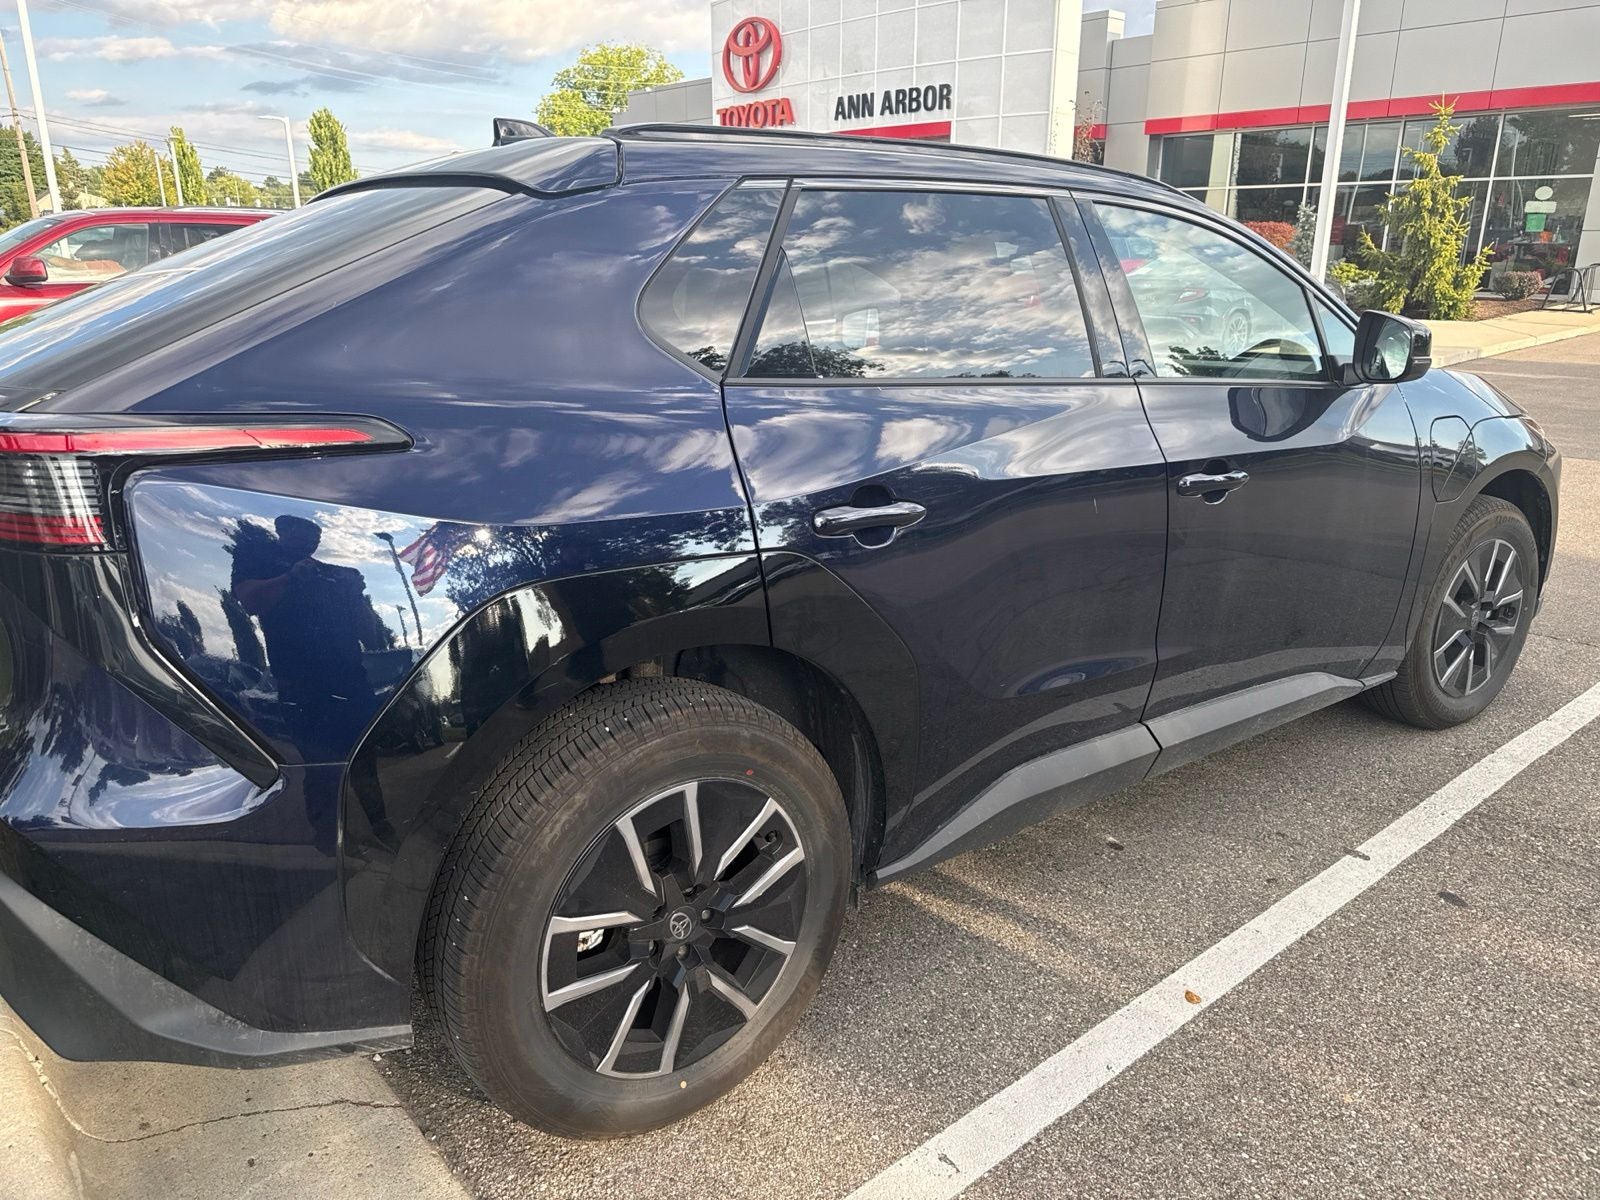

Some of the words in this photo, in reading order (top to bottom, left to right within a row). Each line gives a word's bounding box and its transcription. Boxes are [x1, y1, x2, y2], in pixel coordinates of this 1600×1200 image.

[717, 98, 794, 128] TOYOTA
[834, 92, 875, 120] ANN
[880, 83, 952, 116] ARBOR
